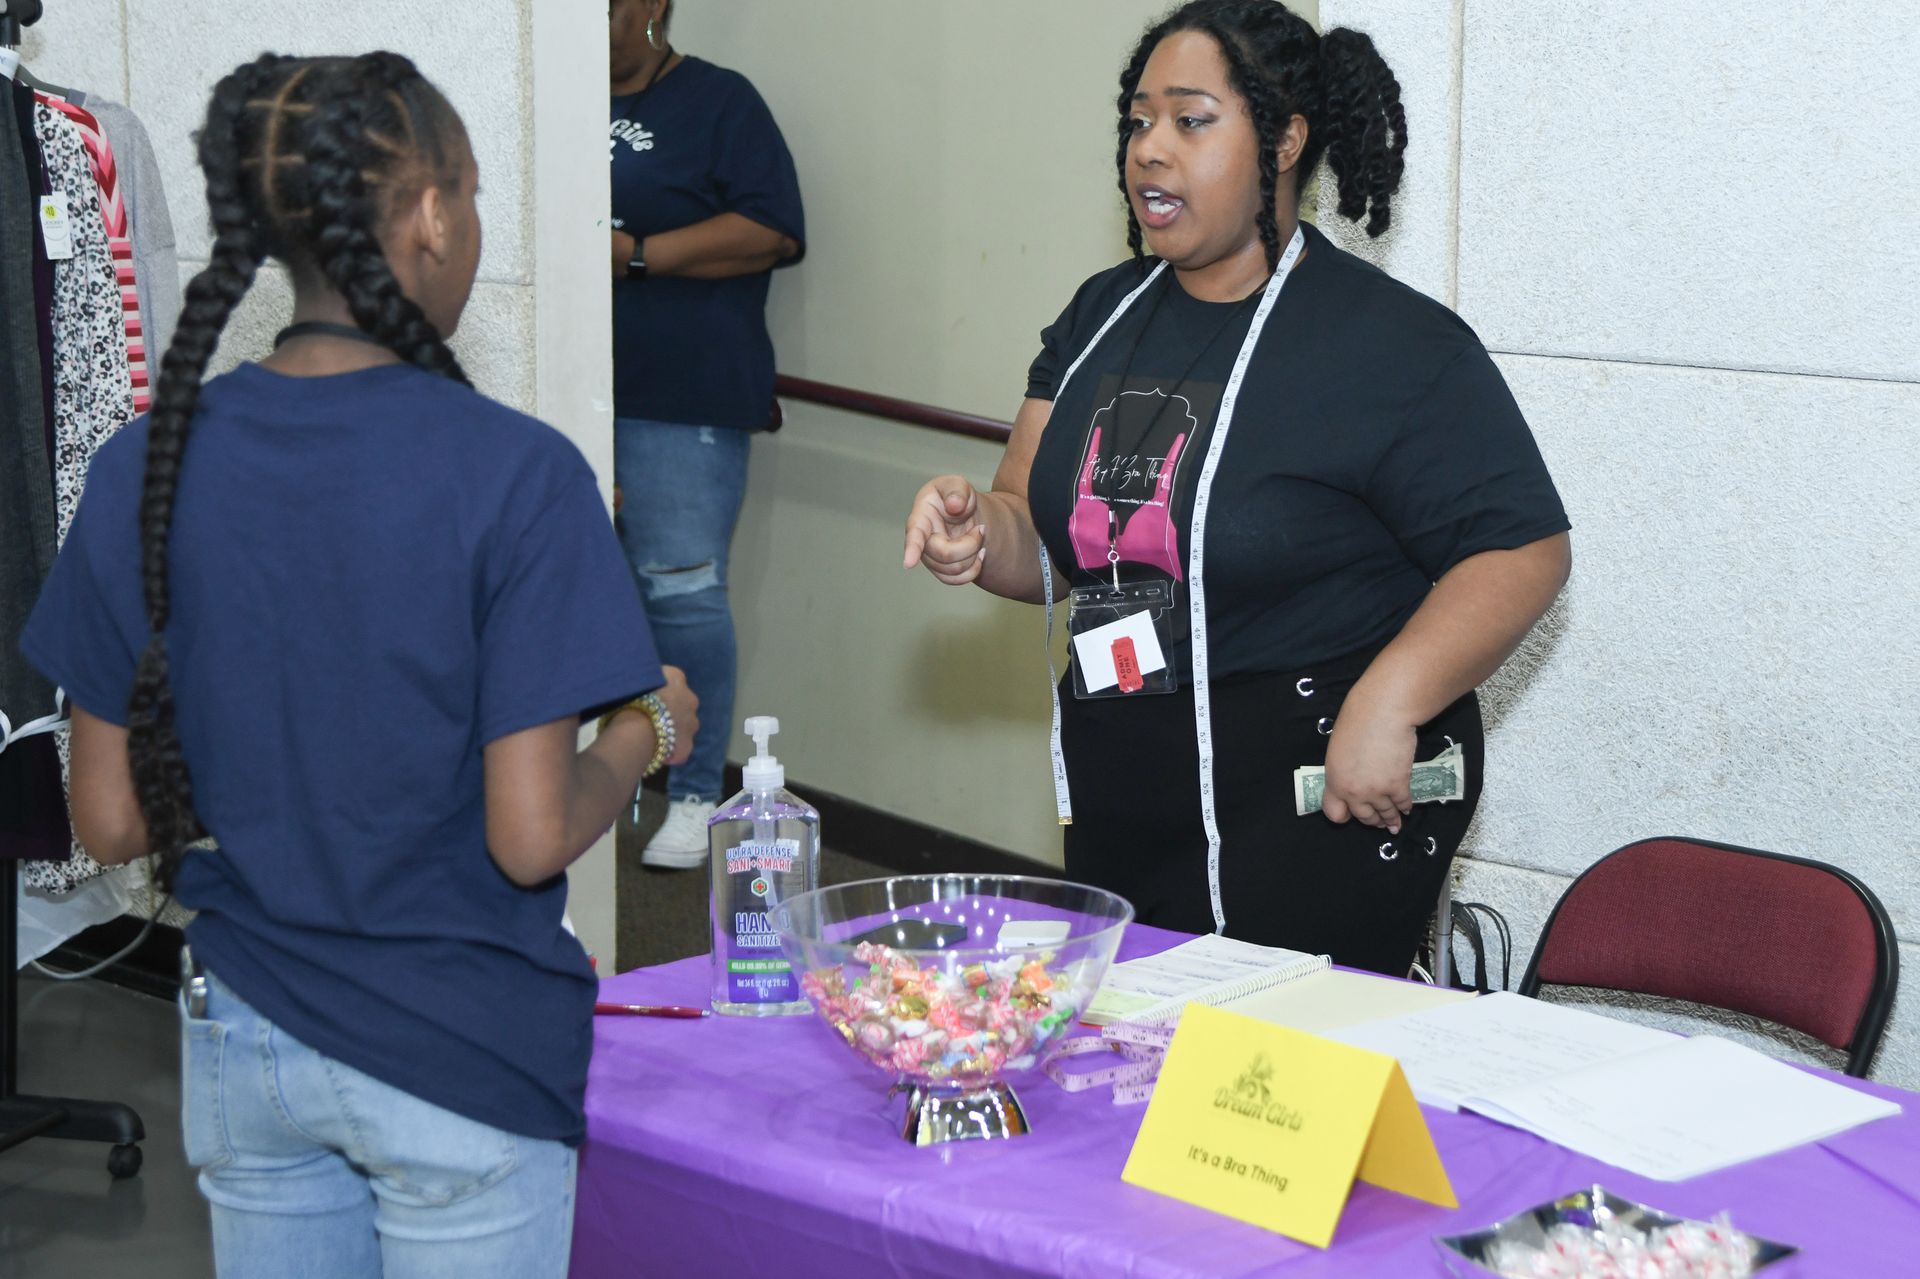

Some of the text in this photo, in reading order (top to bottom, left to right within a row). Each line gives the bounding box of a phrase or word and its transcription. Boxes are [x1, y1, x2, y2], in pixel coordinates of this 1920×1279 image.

[1192, 576, 1198, 587] 47
[1194, 628, 1200, 640] 49
[1196, 680, 1202, 691] 51
[754, 845, 792, 858] DEFENSE
[736, 934, 781, 947] SANITIZE
[1188, 1144, 1288, 1192] It's a Bra Thing
